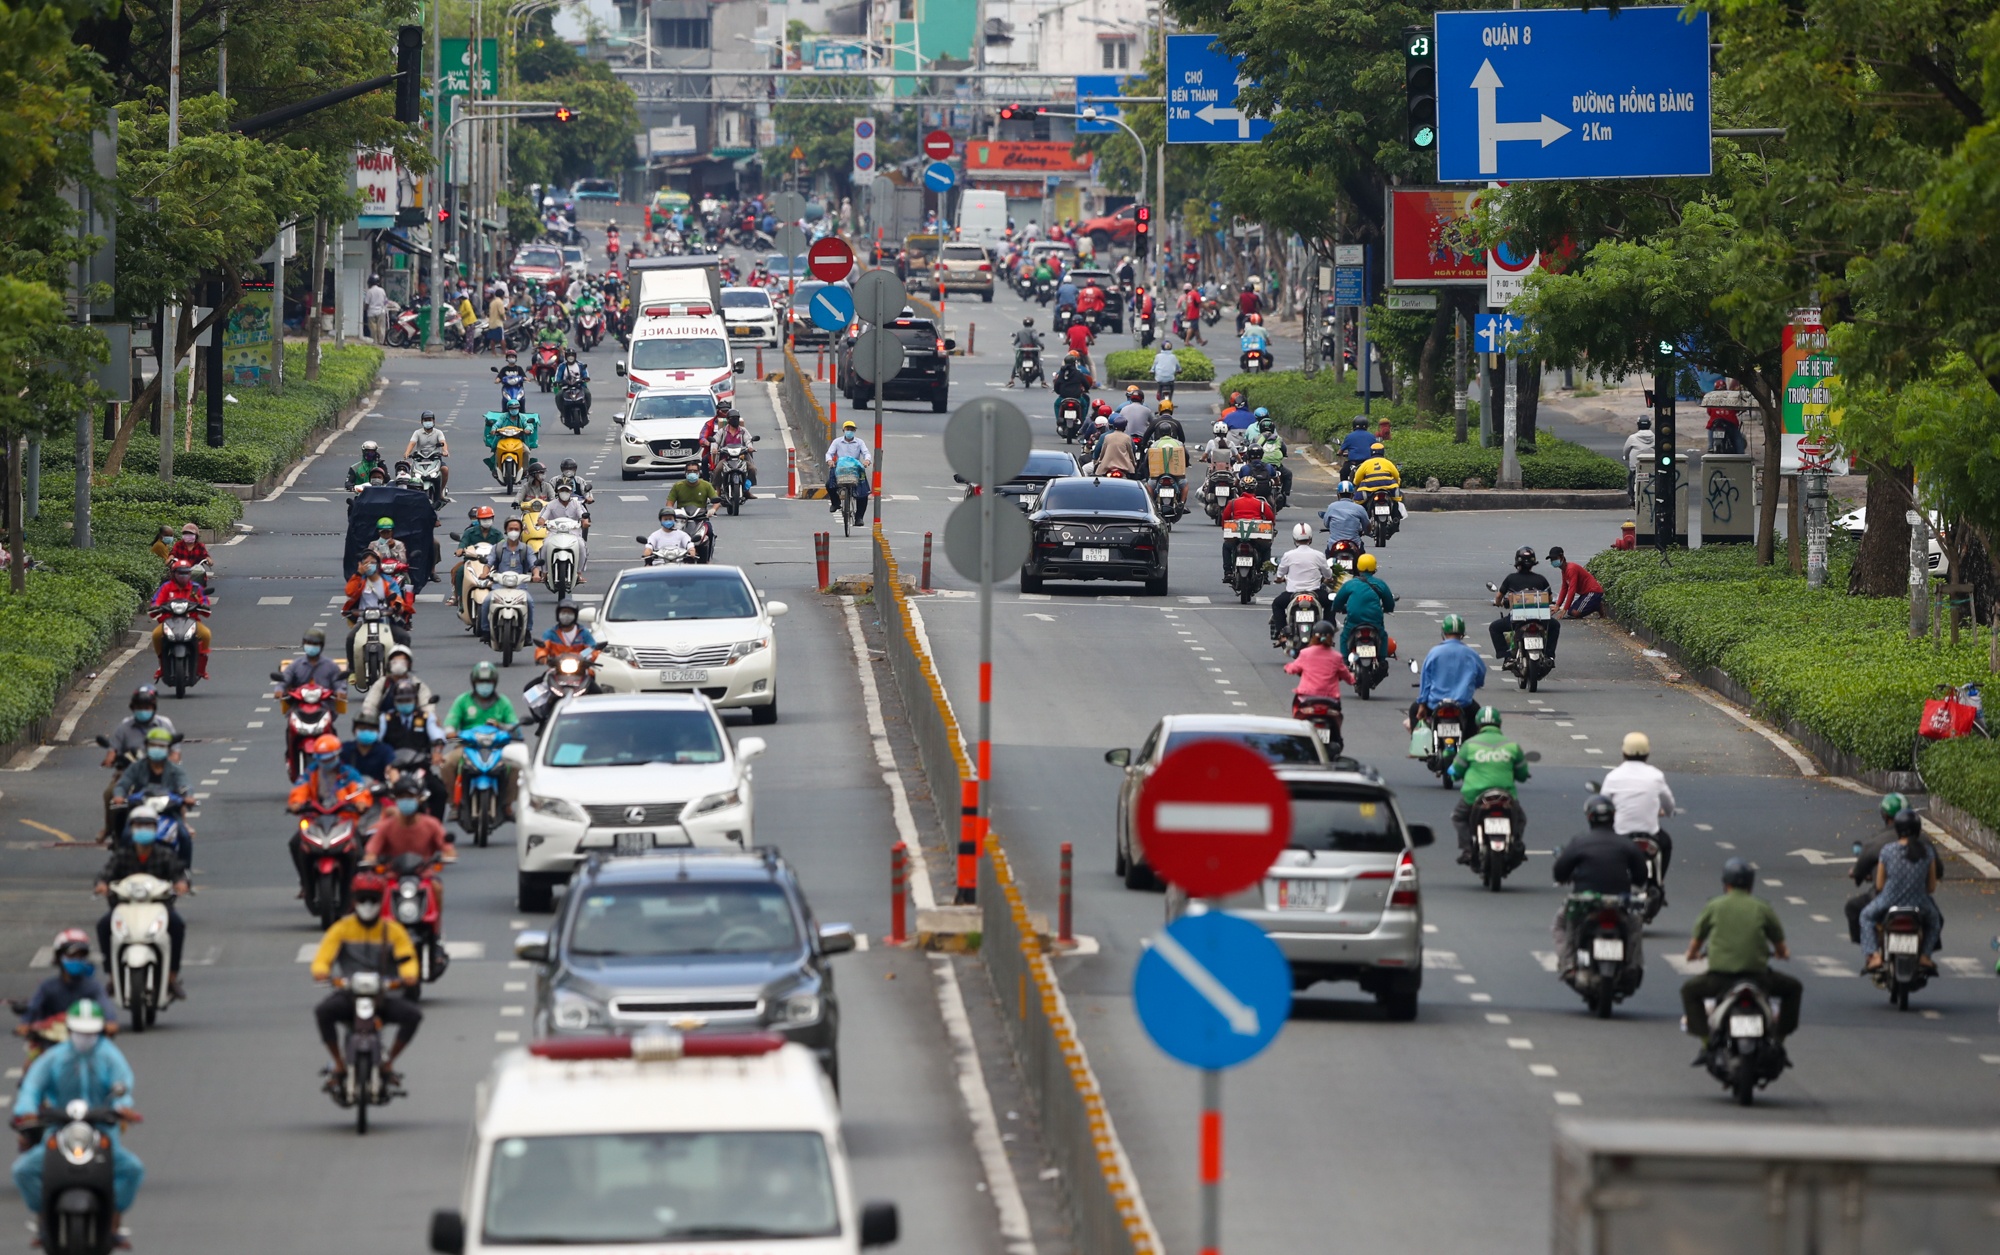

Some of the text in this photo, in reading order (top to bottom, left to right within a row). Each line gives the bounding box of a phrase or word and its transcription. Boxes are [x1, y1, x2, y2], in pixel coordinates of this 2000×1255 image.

[1482, 22, 1532, 51] QUẬN 8
[1410, 37, 1429, 56] 23
[1184, 69, 1203, 85] CHỢ
[1171, 87, 1219, 102] BẾN THÀNH
[1572, 86, 1694, 113] ĐƯỜNG HỒNG BÀNG
[1475, 750, 1512, 763] Grab
